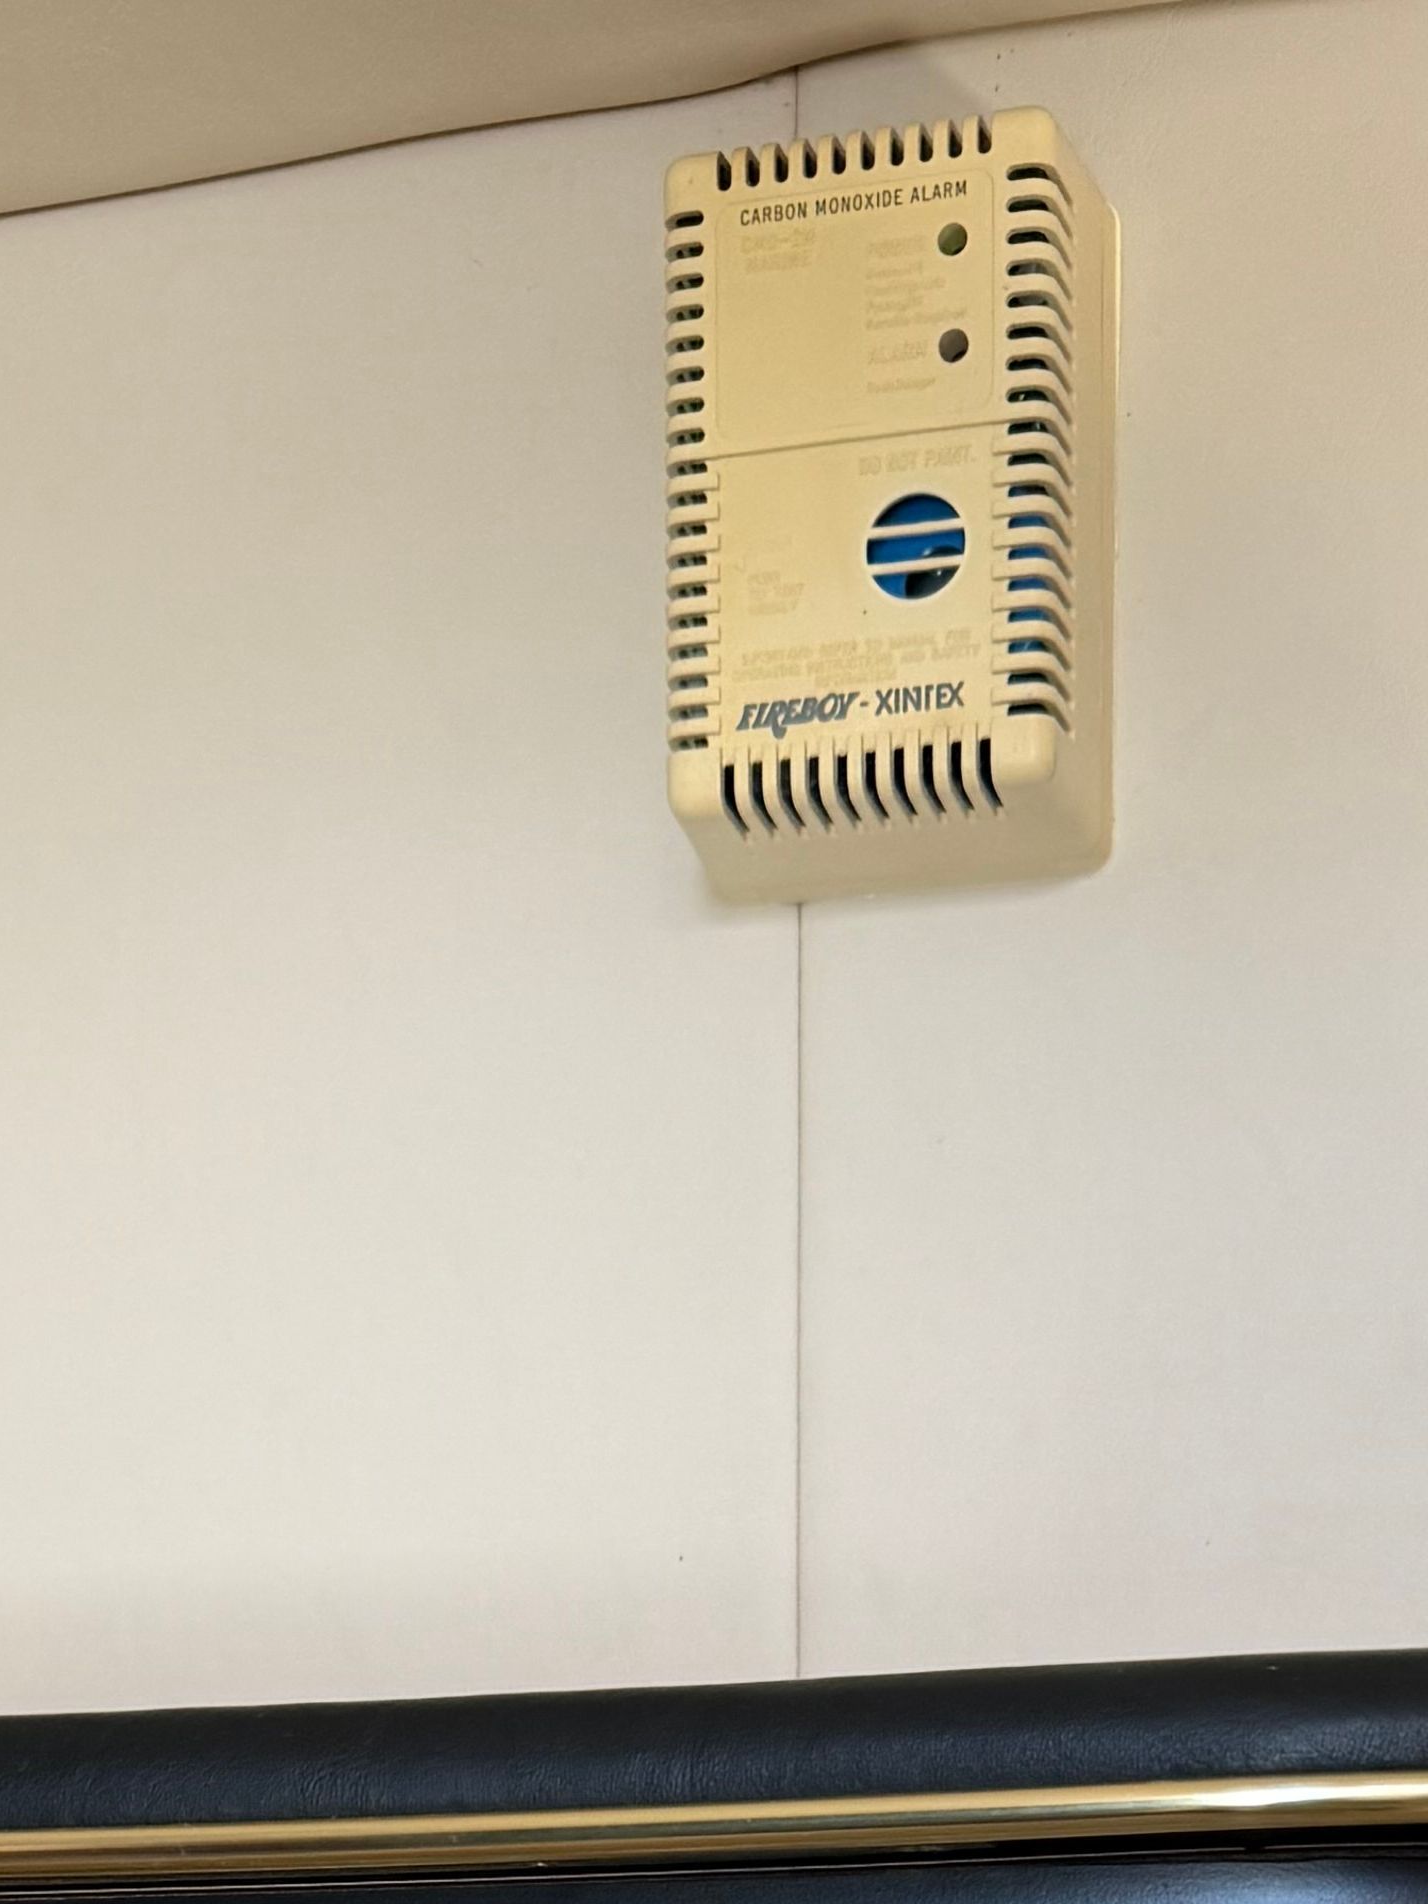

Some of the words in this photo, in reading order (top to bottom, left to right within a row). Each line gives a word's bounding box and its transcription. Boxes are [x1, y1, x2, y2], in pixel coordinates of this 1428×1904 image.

[740, 202, 808, 226] CARBON
[815, 188, 904, 216] MONOXIDE
[909, 180, 968, 204] ALARM
[735, 691, 861, 740] FIREBOY
[875, 680, 965, 717] XINTEX
